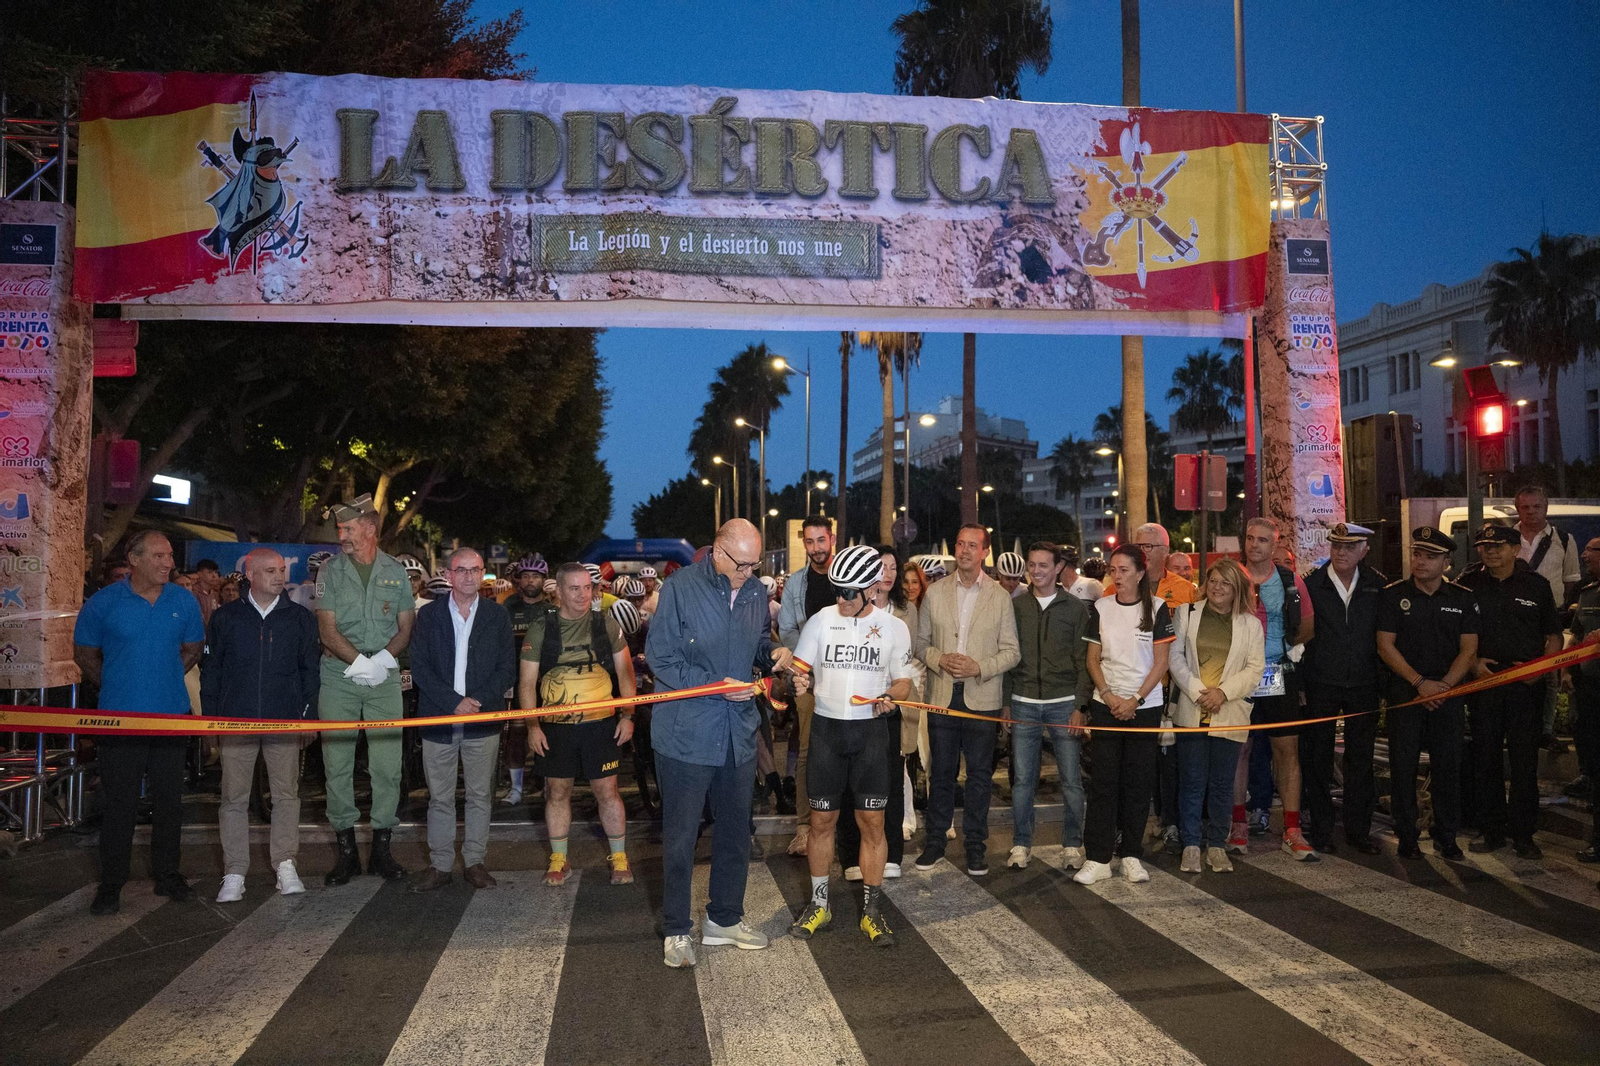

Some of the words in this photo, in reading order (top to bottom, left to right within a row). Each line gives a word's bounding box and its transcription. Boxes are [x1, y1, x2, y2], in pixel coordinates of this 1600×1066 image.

[335, 108, 467, 190] LA
[489, 96, 1057, 204] DESÉRTICA
[568, 230, 588, 250] La
[598, 228, 650, 254] Legión
[660, 235, 670, 255] y
[679, 233, 693, 252] el
[702, 234, 768, 255] desierto
[777, 241, 805, 256] nos
[814, 241, 843, 257] une
[0, 321, 50, 333] RENTA
[1293, 323, 1332, 334] RENTA
[1293, 336, 1333, 350] TODO
[1298, 443, 1340, 454] primaflor
[491, 544, 504, 558] P
[824, 641, 881, 666] LEGIÓN
[76, 718, 121, 727] ALMERÍA
[601, 759, 619, 772] ARMY
